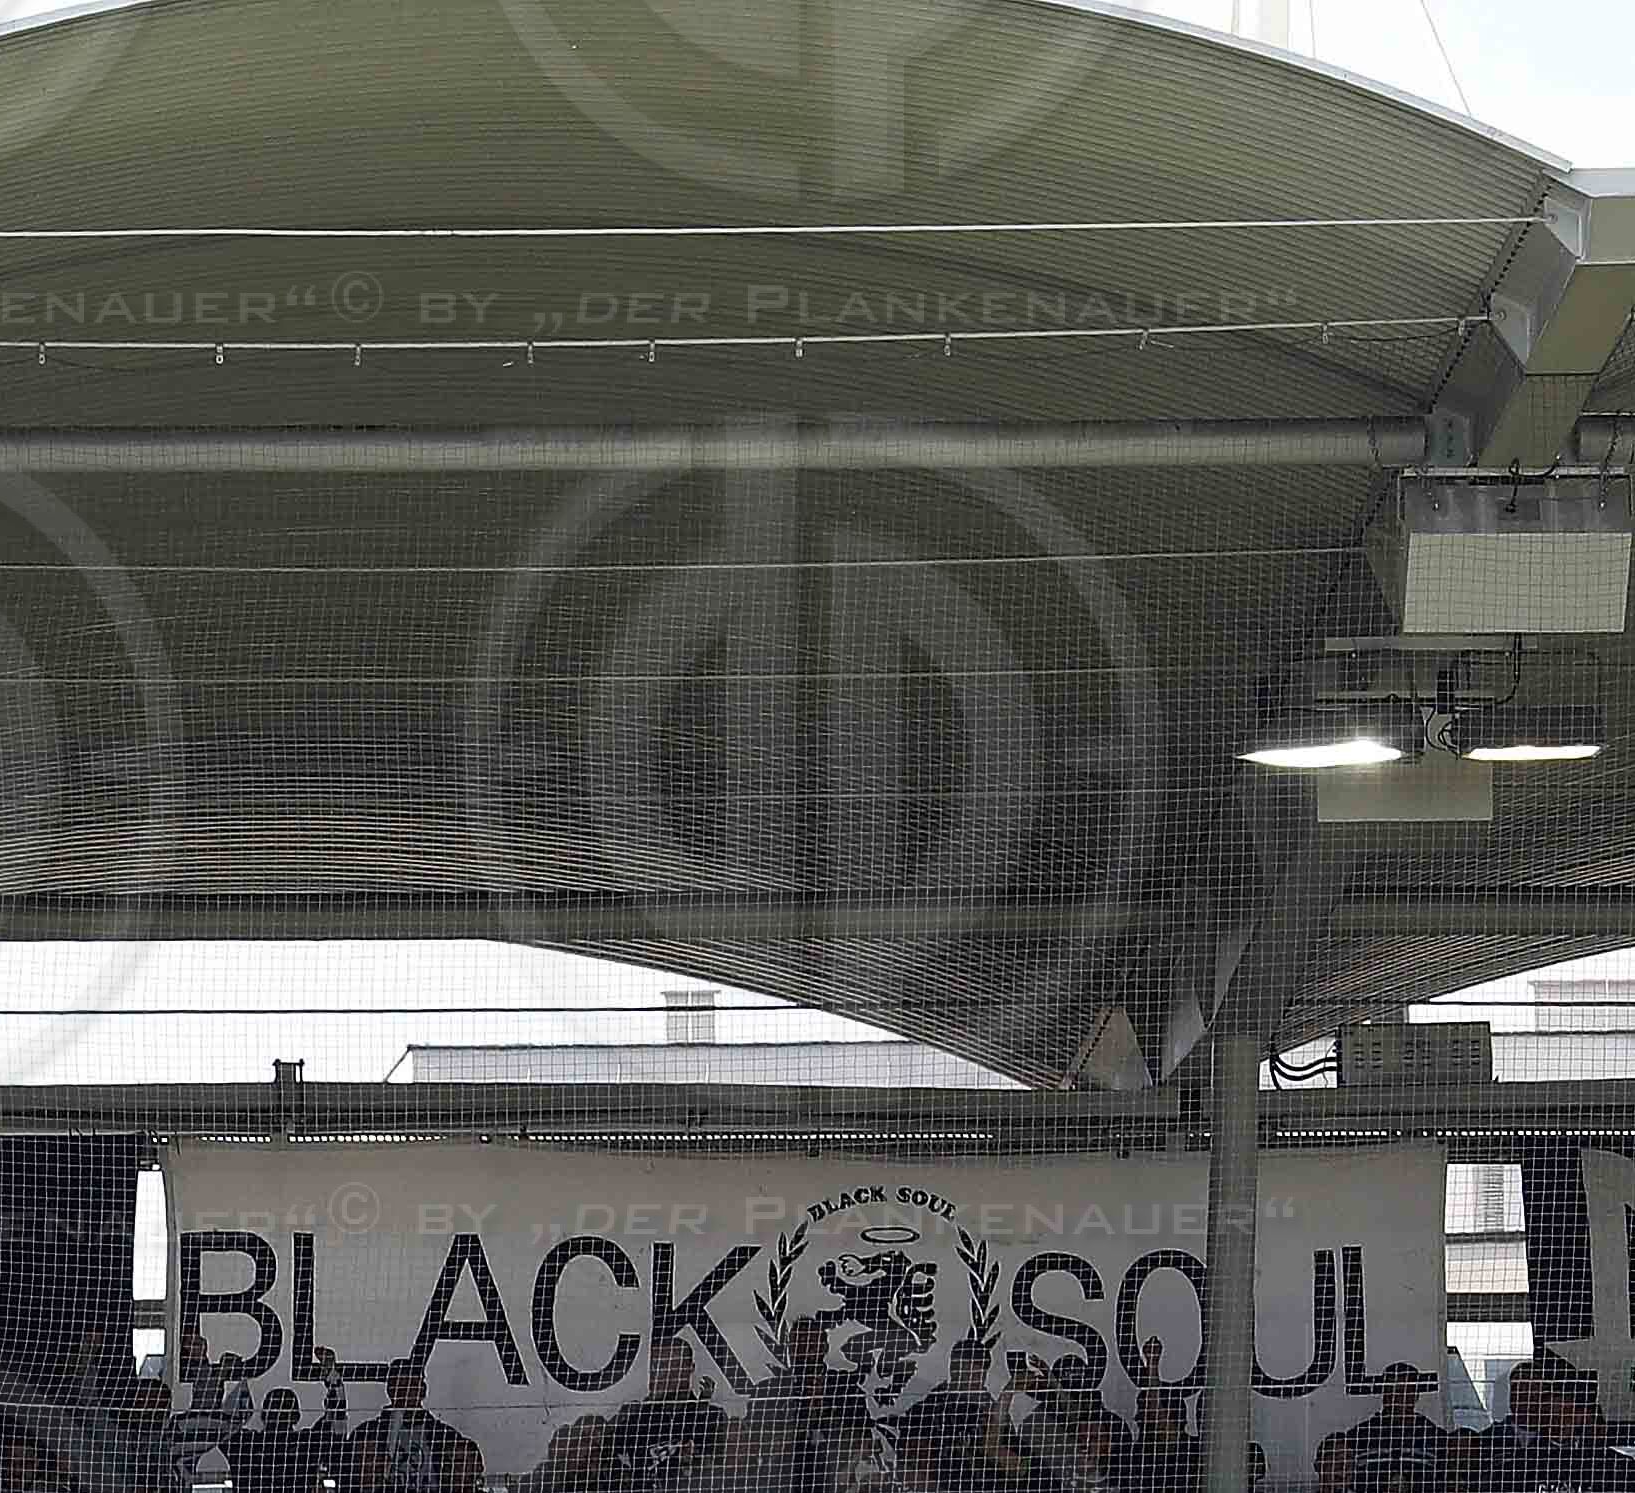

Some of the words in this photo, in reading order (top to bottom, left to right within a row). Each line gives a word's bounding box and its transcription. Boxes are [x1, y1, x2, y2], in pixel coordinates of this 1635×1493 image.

[808, 1184, 886, 1224] BLACK
[895, 1184, 957, 1223] SOUL
[182, 1230, 777, 1394] BLACK
[1008, 1240, 1438, 1396] SOUL
